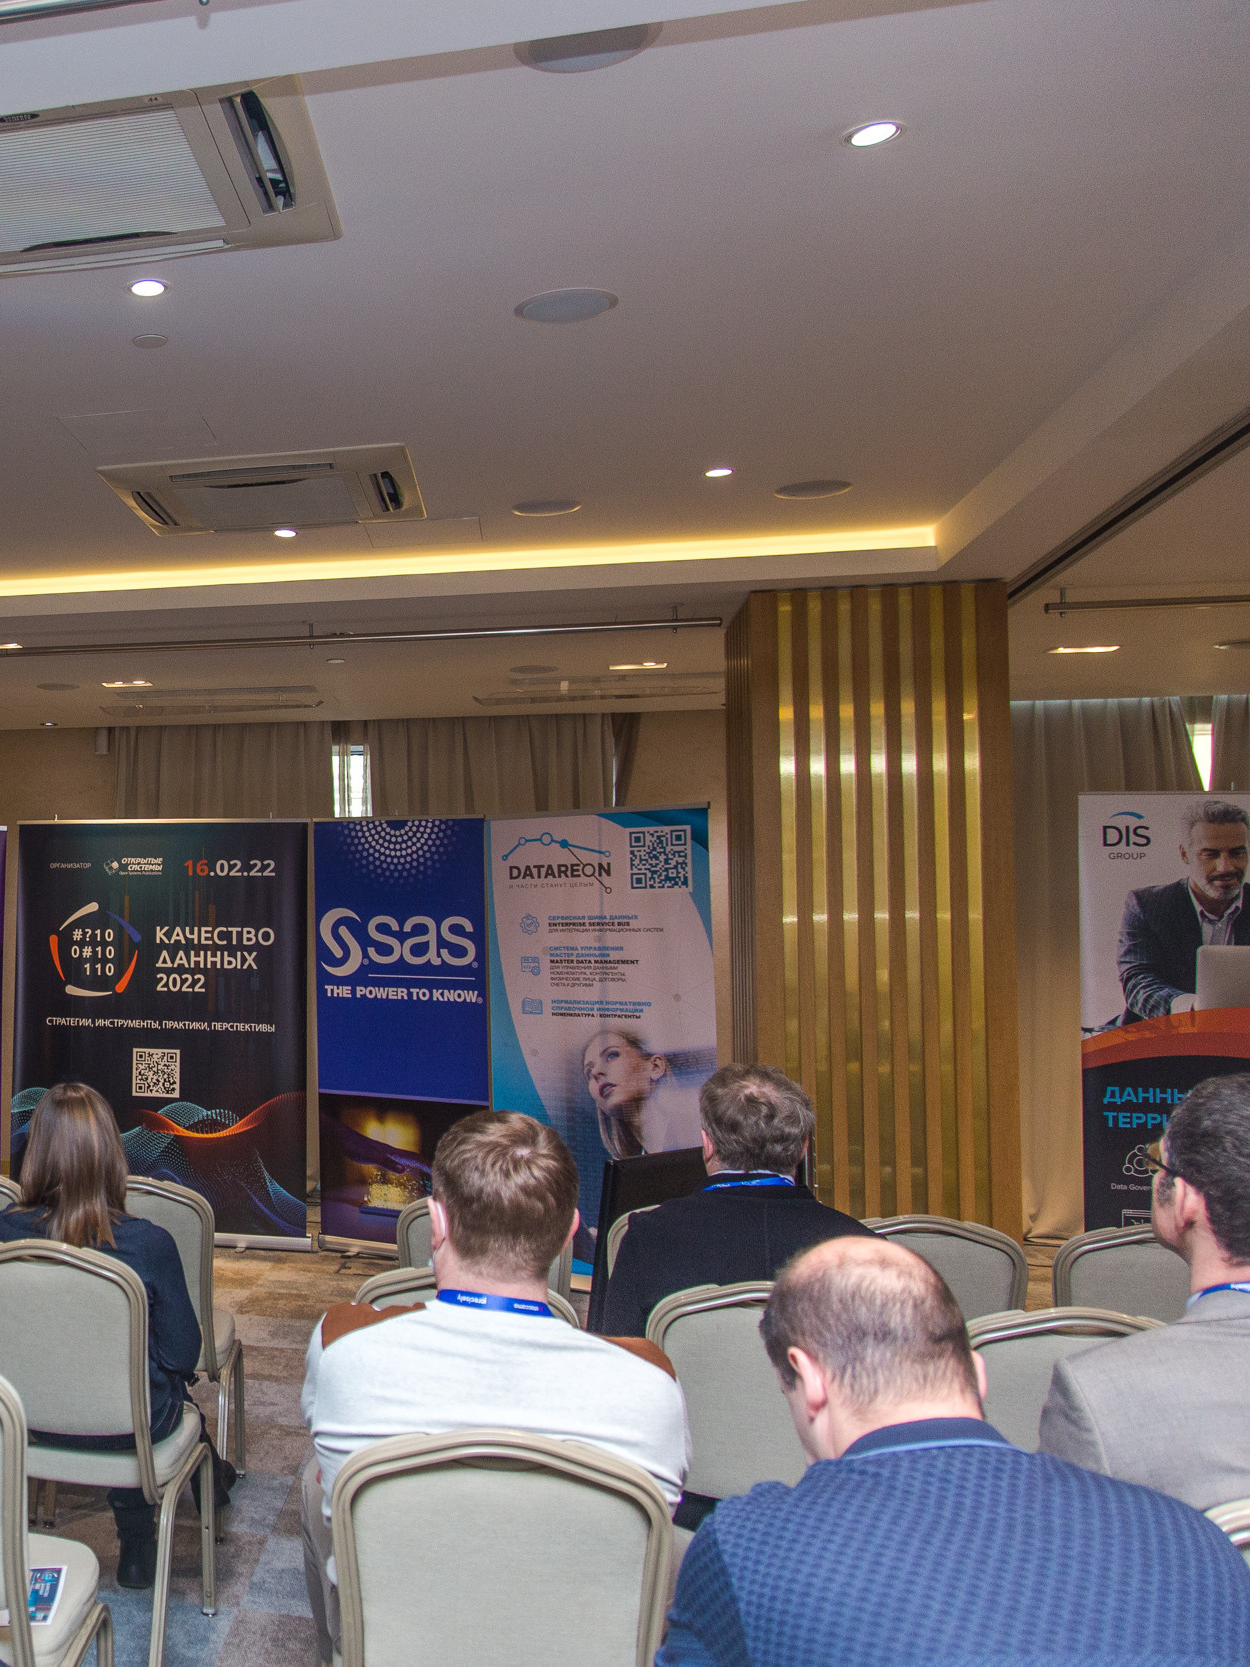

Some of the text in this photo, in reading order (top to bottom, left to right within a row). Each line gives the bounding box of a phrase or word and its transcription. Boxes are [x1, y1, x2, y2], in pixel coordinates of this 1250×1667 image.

[1102, 825, 1151, 847] DIS
[184, 860, 276, 876] 16.02.22
[509, 862, 611, 880] DATAREON
[156, 926, 275, 945] КАЧЕСТВО
[155, 950, 258, 970] ДАННЫХ
[156, 973, 206, 992] 2022
[324, 985, 352, 998] THE
[356, 986, 408, 1000] POWER
[410, 988, 430, 1000] TO
[46, 1017, 275, 1032] СТРАТЕГИИ, ИНСТРУМЕНТЫ, ПРАКТИКИ, ПЕРСПЕКТИВЫ
[1103, 1086, 1193, 1104] ДАННЫ
